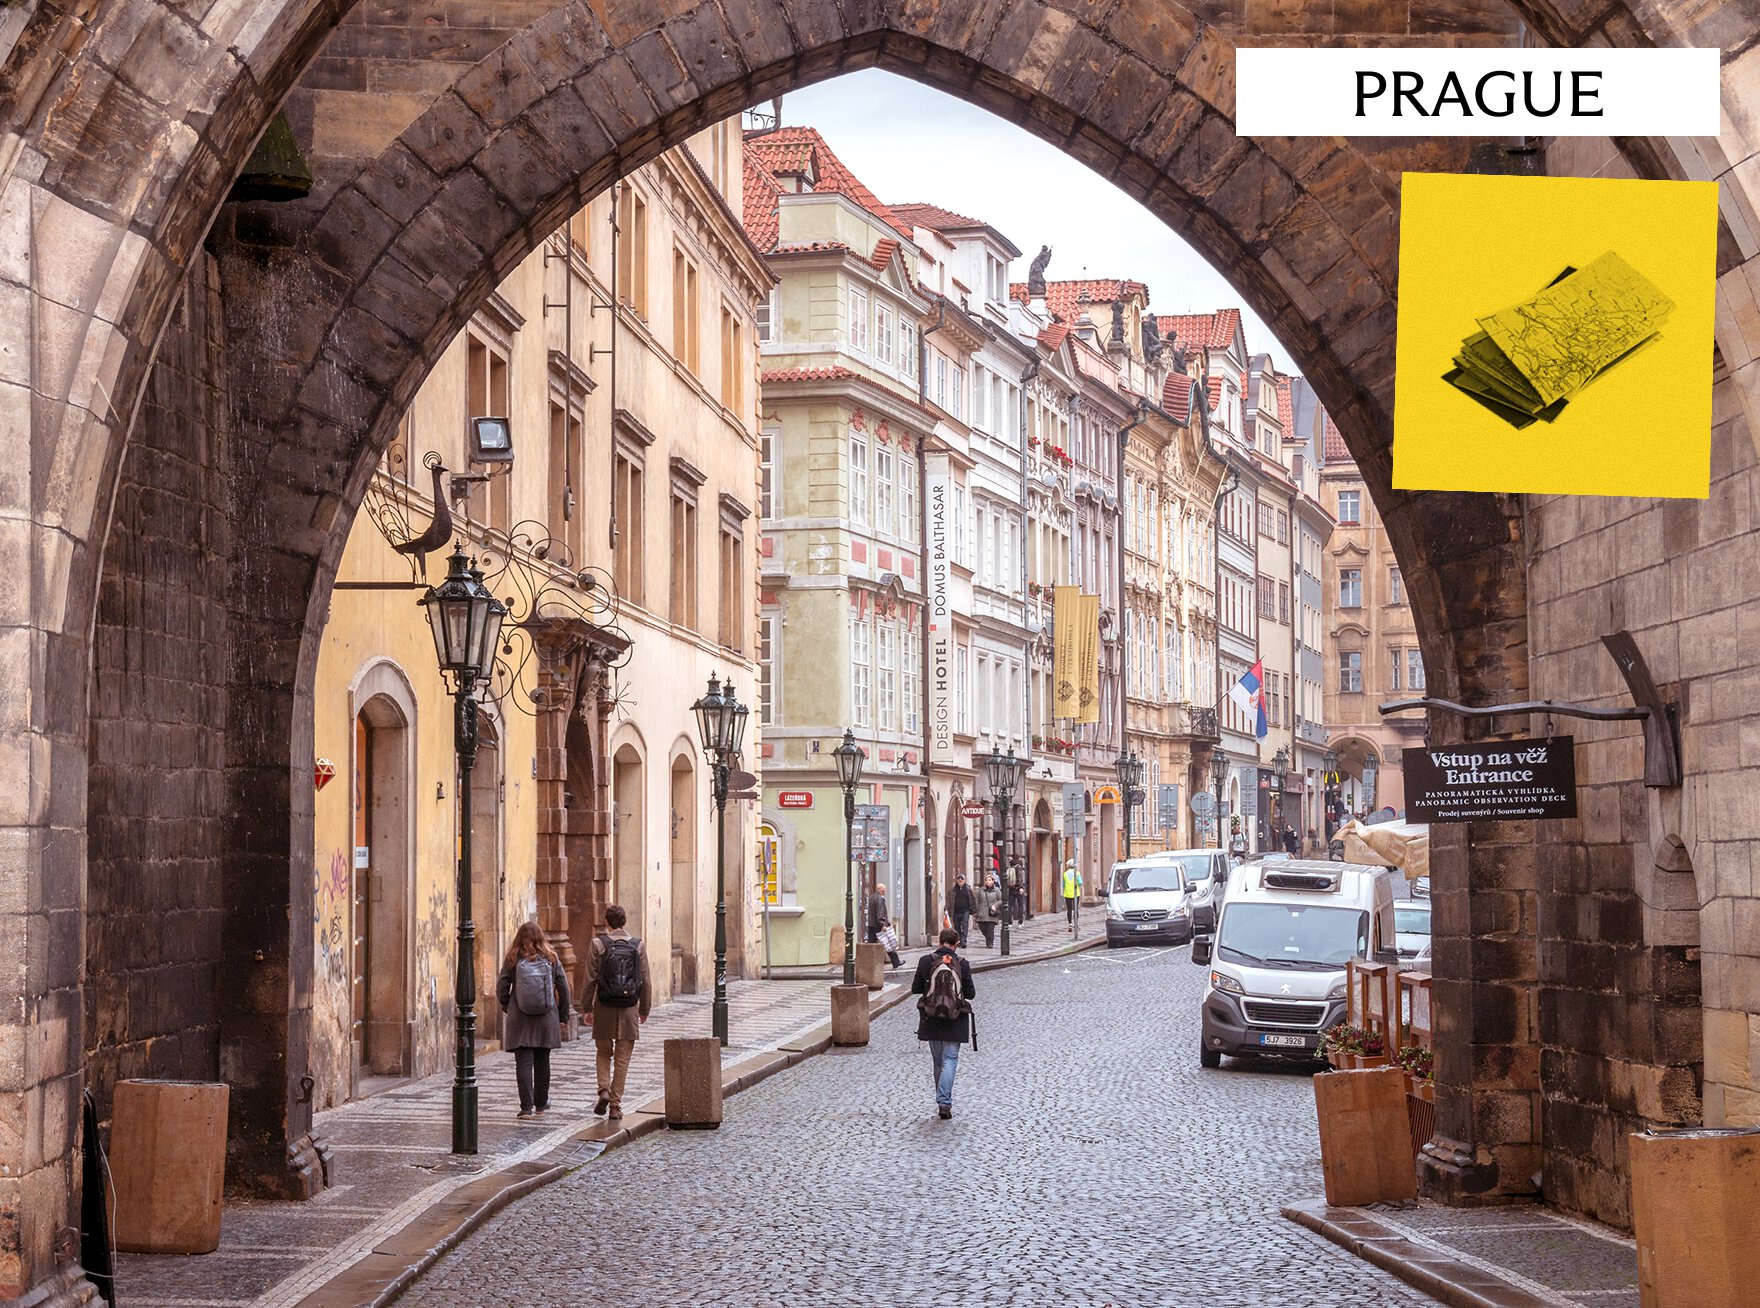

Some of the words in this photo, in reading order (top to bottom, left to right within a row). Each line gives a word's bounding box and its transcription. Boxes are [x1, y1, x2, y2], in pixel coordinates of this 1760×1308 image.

[932, 485, 945, 559] BALTHASAR
[934, 564, 946, 616] DOMUS
[936, 639, 947, 690] HOTEL
[936, 697, 948, 749] DESIGN
[1431, 752, 1483, 771] Vstup
[1487, 753, 1512, 766] na
[1514, 747, 1548, 764] věž
[1445, 769, 1534, 785] Entrance
[1415, 798, 1470, 807] PANORAMIC
[1473, 796, 1538, 805] OBSERVATION
[1541, 794, 1567, 802] DECK
[1425, 788, 1504, 798] PANORAMATICKÁ
[1507, 786, 1556, 795] VYHLÍDKA
[1438, 810, 1460, 818] Prodej
[1461, 808, 1491, 817] suvenýrů
[1497, 807, 1526, 816] Souvenir
[1527, 807, 1544, 815] shop
[1266, 1035, 1280, 1044] 5J7
[1284, 1036, 1302, 1046] 3926
